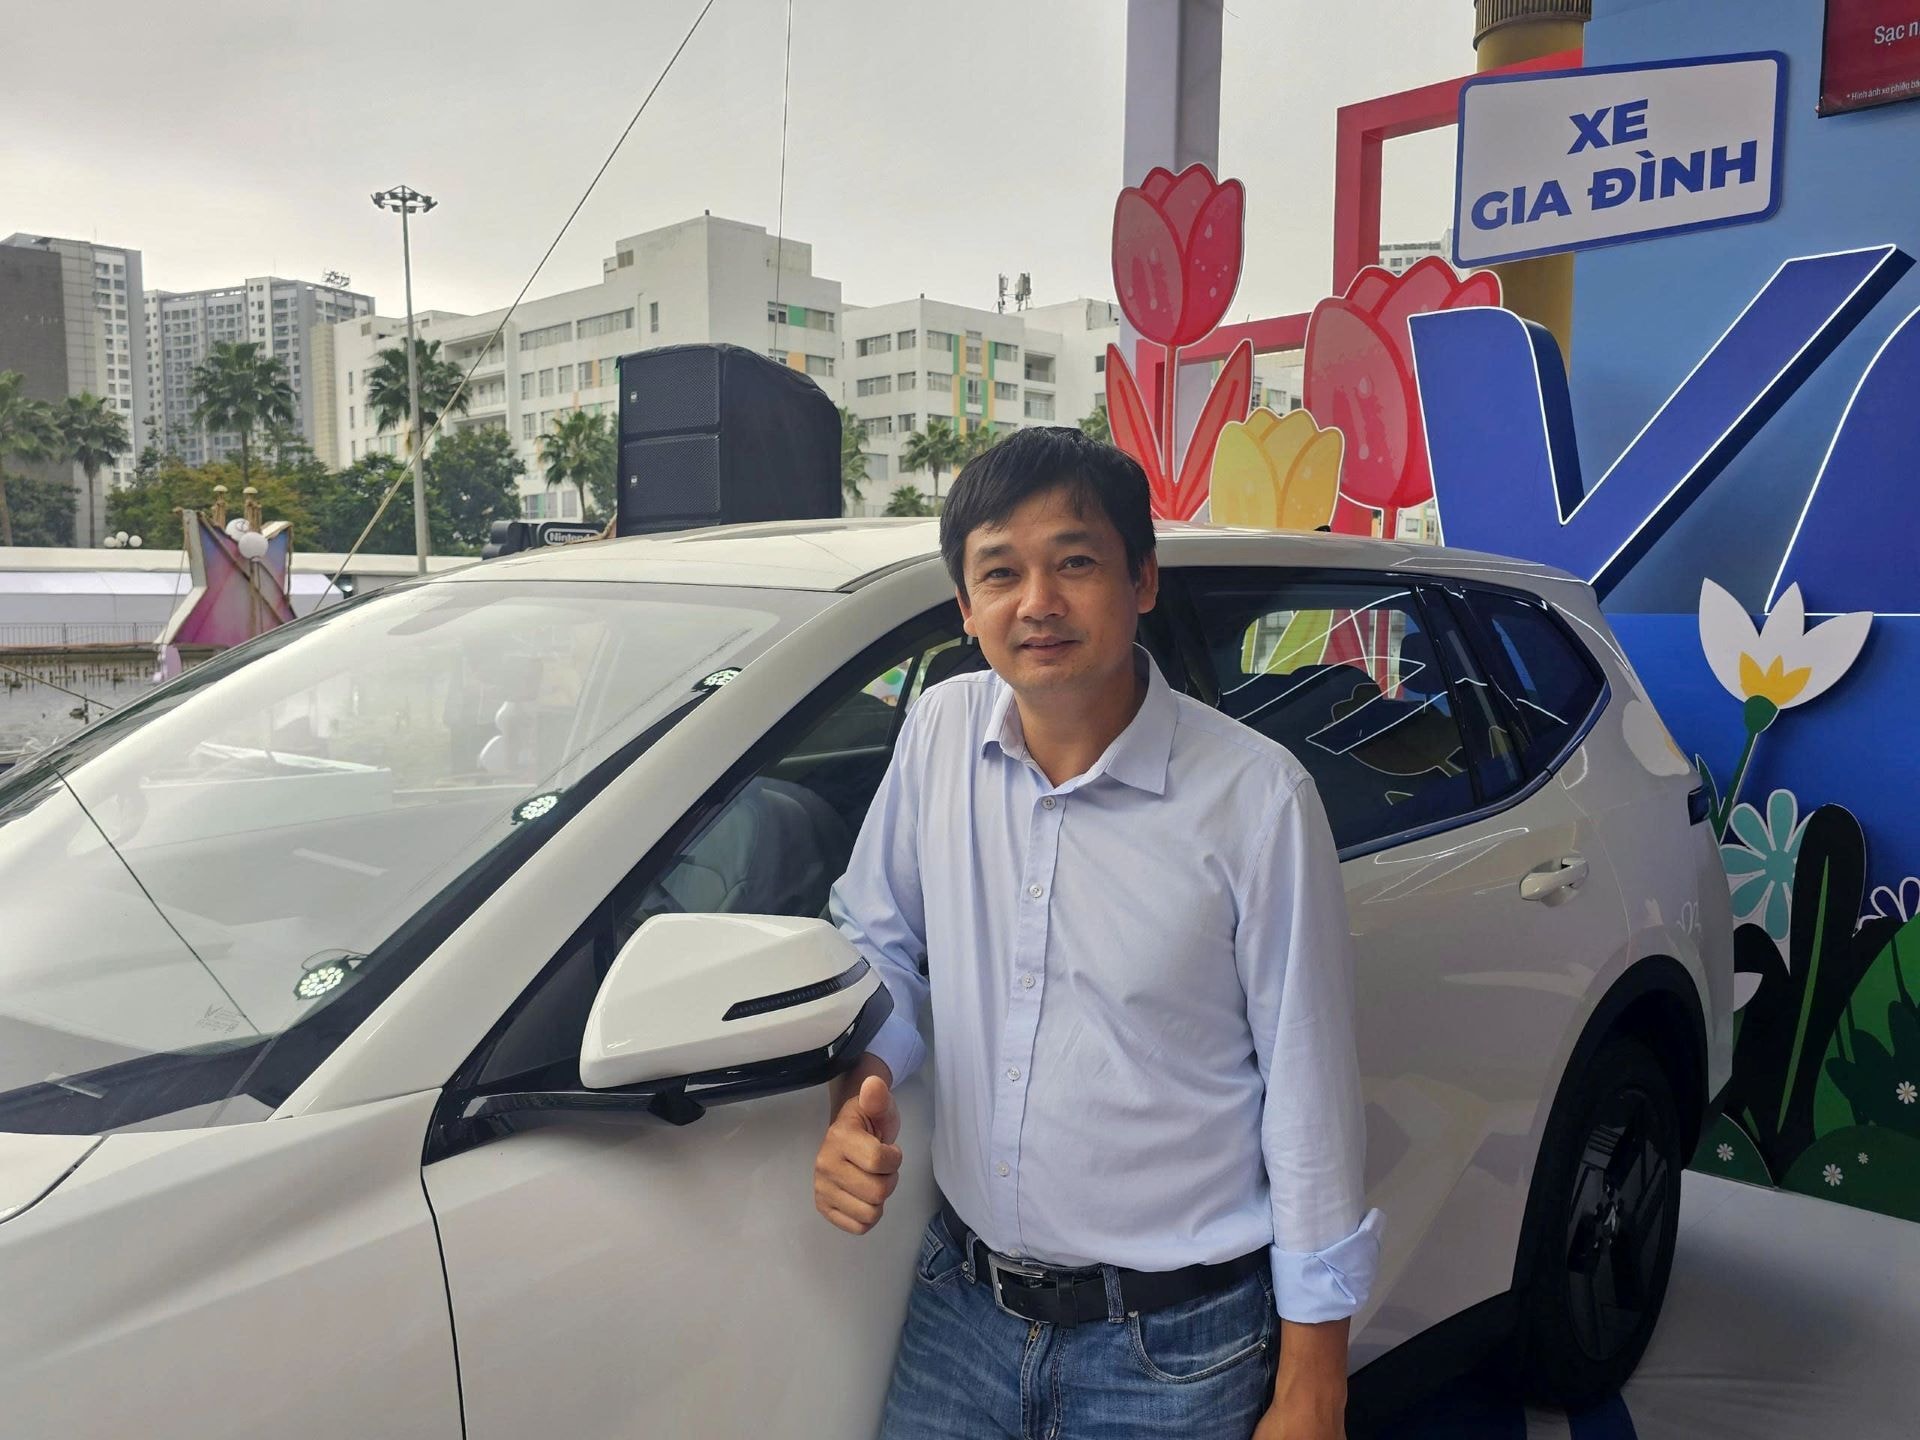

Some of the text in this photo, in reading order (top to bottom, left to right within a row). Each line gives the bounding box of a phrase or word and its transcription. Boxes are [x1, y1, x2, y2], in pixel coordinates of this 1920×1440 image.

[1874, 21, 1920, 46] Sạc n
[1567, 98, 1649, 155] XE
[1471, 139, 1758, 231] GIA ĐÌNH
[550, 532, 596, 542] Nintend
